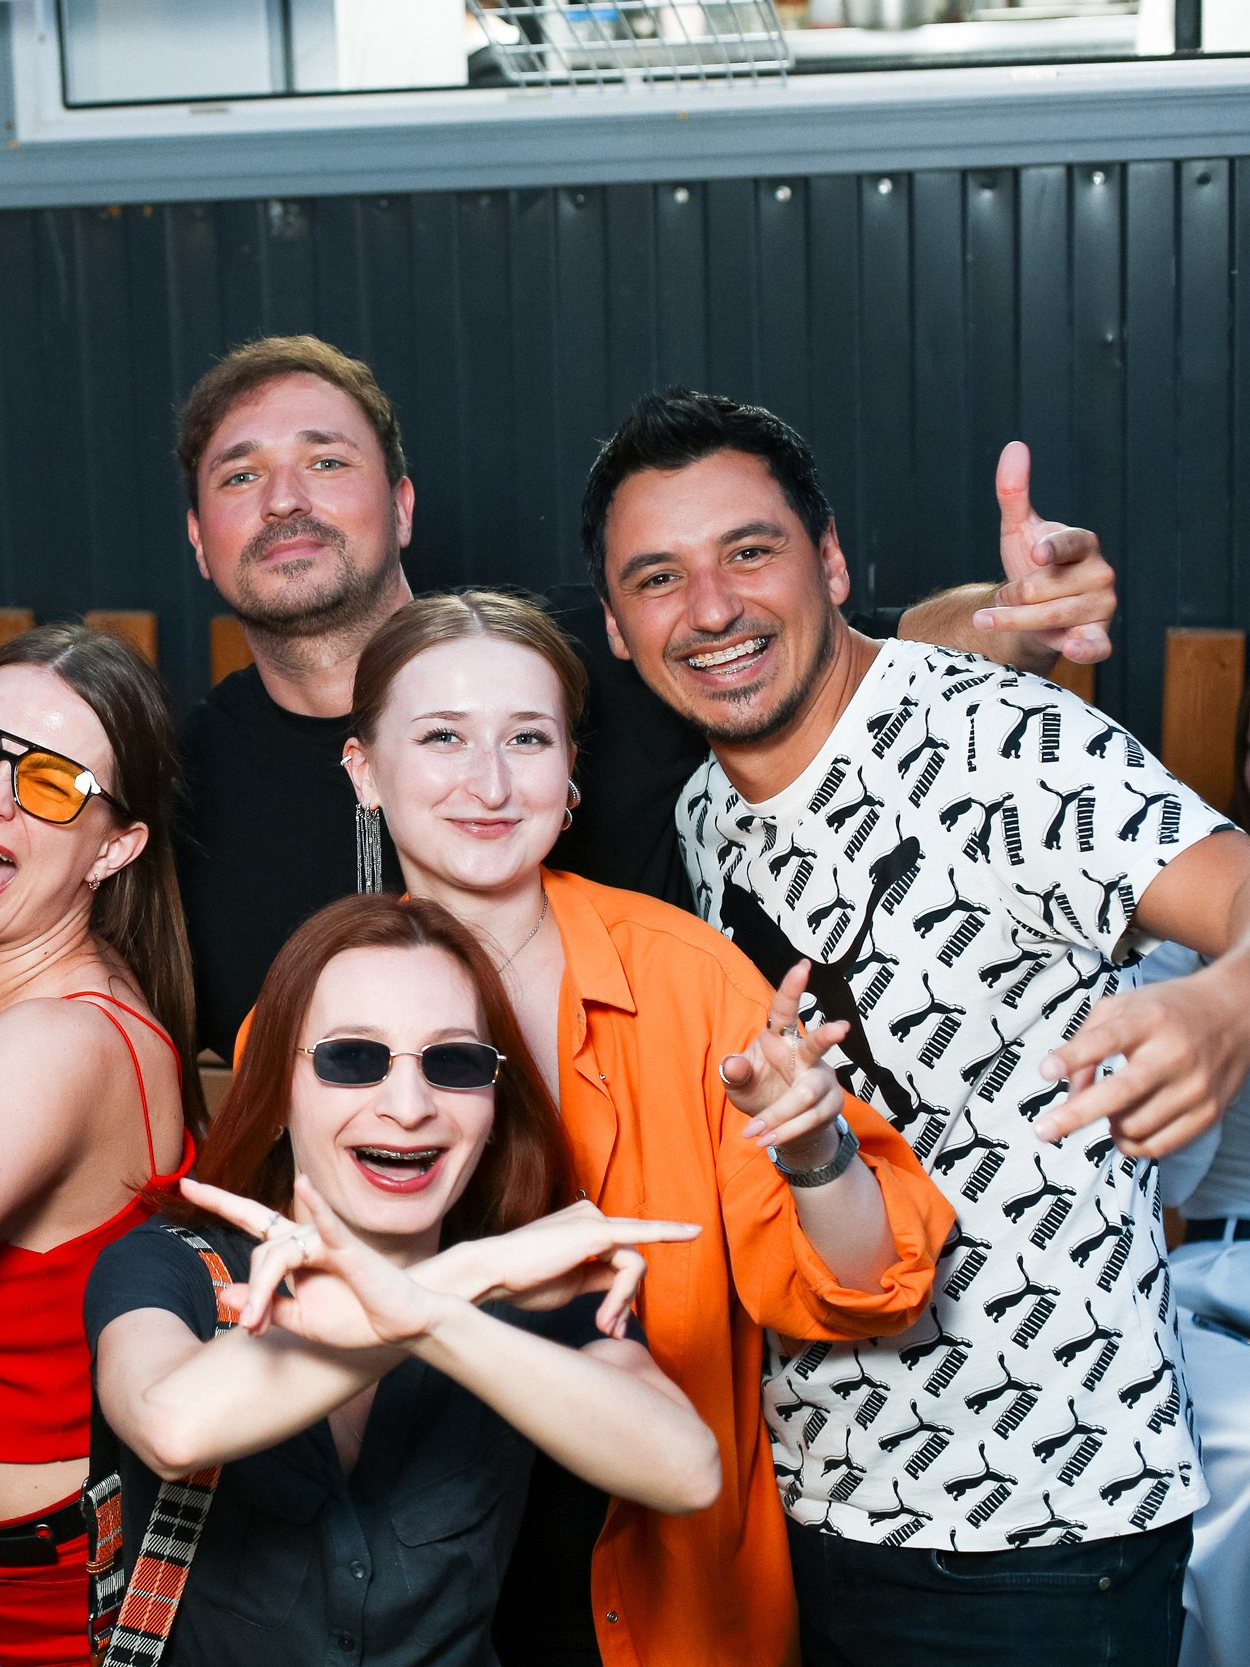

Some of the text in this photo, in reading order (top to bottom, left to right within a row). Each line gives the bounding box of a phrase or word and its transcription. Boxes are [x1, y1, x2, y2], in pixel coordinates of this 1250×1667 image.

[871, 705, 913, 759] PUMA
[1038, 710, 1061, 763] PUMA
[807, 764, 846, 814] PUMA
[908, 749, 945, 808] PUMA
[843, 805, 880, 863] PUMA
[1001, 804, 1025, 866] PUMA
[1075, 794, 1096, 853] PUMA
[1156, 799, 1182, 845] PUMA
[785, 857, 815, 911] PUMA
[881, 861, 921, 916] PUMA
[820, 910, 851, 964] PUMA
[936, 911, 985, 968] PUMA
[857, 963, 895, 1021] PUMA
[1001, 959, 1047, 1010] PUMA
[916, 1013, 962, 1070] PUMA
[976, 1046, 1021, 1103] PUMA
[960, 1147, 1005, 1203] PUMA
[1028, 1195, 1073, 1250] PUMA
[942, 1247, 988, 1302] PUMA
[1010, 1294, 1057, 1350] PUMA
[922, 1346, 968, 1398] PUMA
[1081, 1338, 1119, 1392] PUMA
[854, 1387, 888, 1431] PUMA
[992, 1390, 1038, 1440] PUMA
[903, 1431, 950, 1480] PUMA
[1056, 1434, 1103, 1487] PUMA
[965, 1482, 1012, 1529] PUMA
[1128, 1478, 1170, 1531] PUMA
